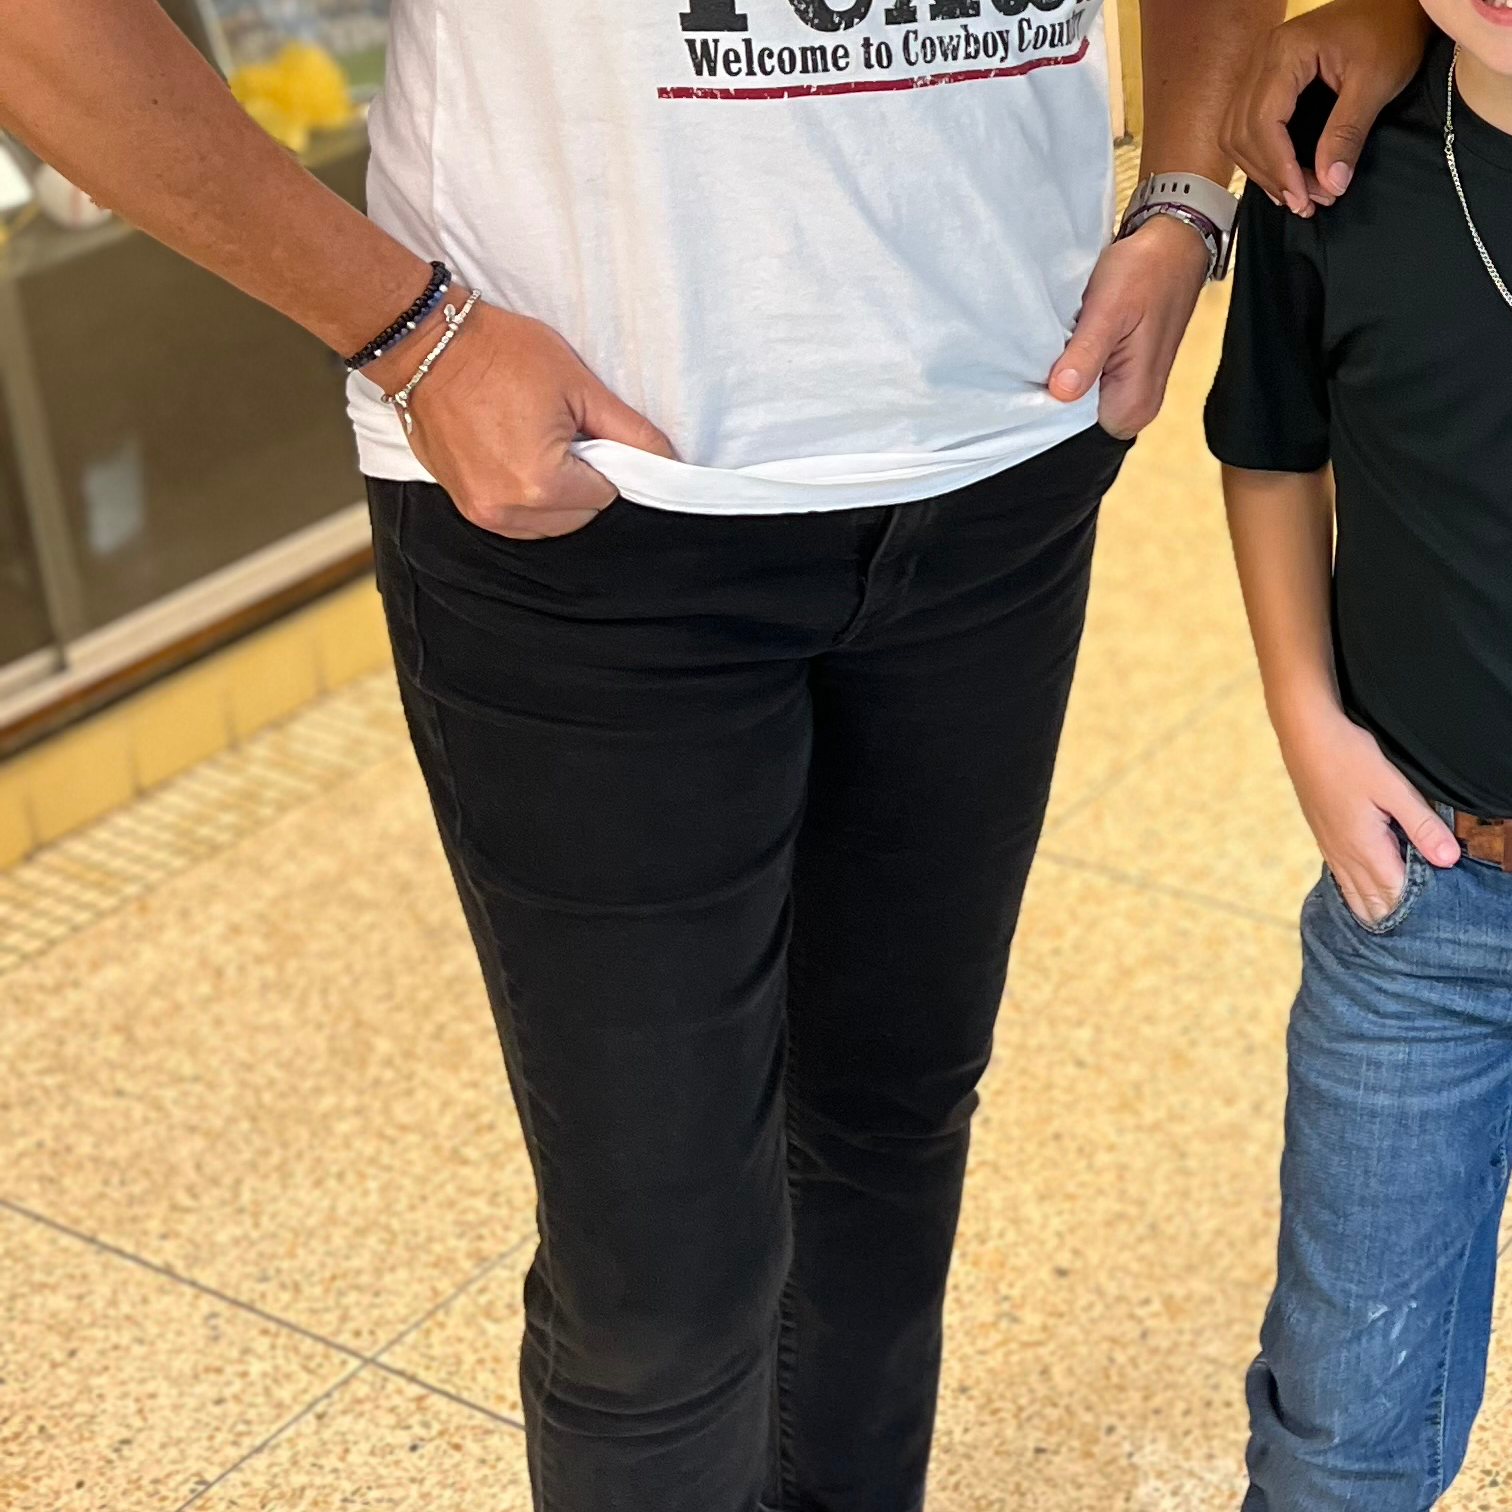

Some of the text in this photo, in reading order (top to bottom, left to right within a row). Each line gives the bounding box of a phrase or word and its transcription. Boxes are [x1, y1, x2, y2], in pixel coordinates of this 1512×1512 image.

[683, 7, 1086, 78] Welcome to Cowboy Coun
